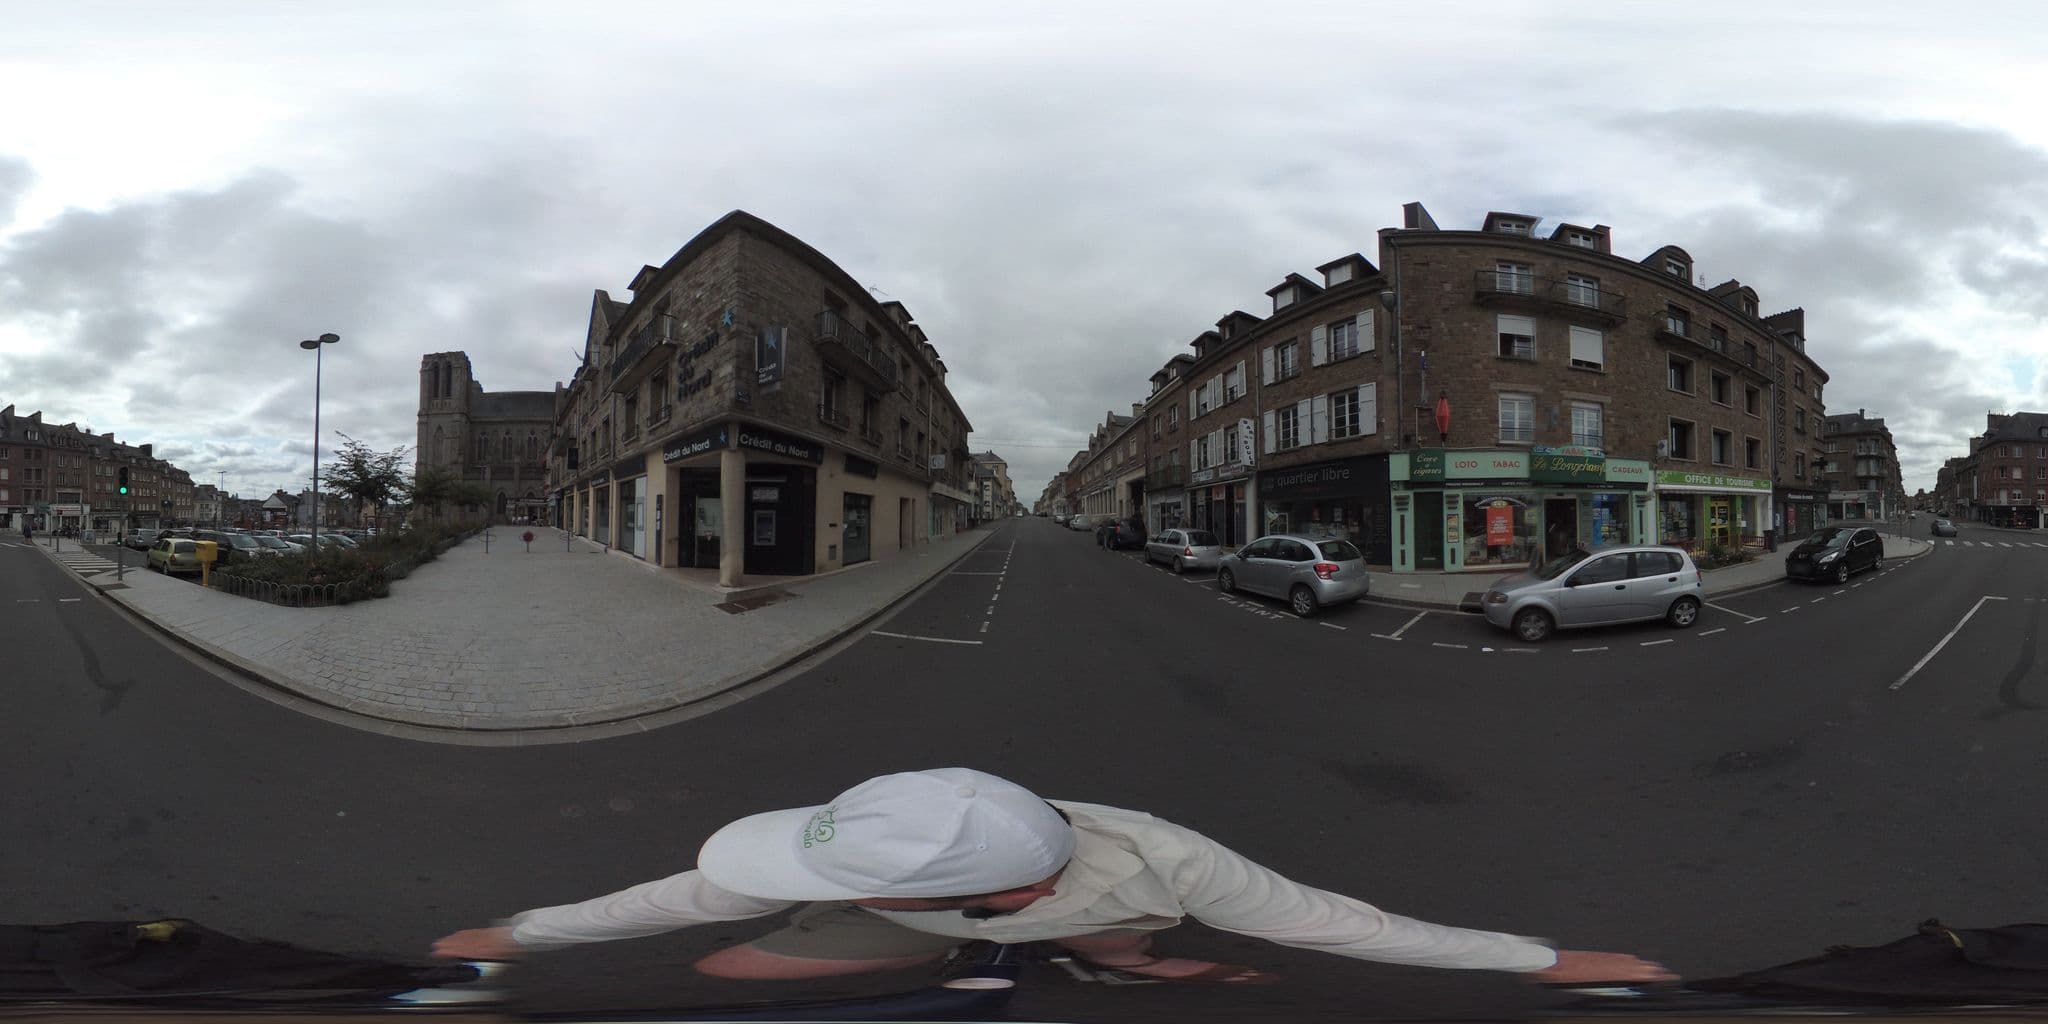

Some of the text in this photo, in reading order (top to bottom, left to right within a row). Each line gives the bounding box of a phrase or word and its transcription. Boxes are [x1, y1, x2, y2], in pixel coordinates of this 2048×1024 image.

[681, 446, 691, 456] du
[691, 438, 710, 453] Nord
[740, 433, 809, 458] Crédit du Nord
[1455, 460, 1521, 469] LOTO TABAC
[1612, 466, 1643, 474] CADEAUX
[1277, 467, 1350, 488] quartier libre
[1685, 474, 1712, 484] OFFICE
[1714, 476, 1724, 485] DE
[1726, 477, 1754, 487] TOURISME
